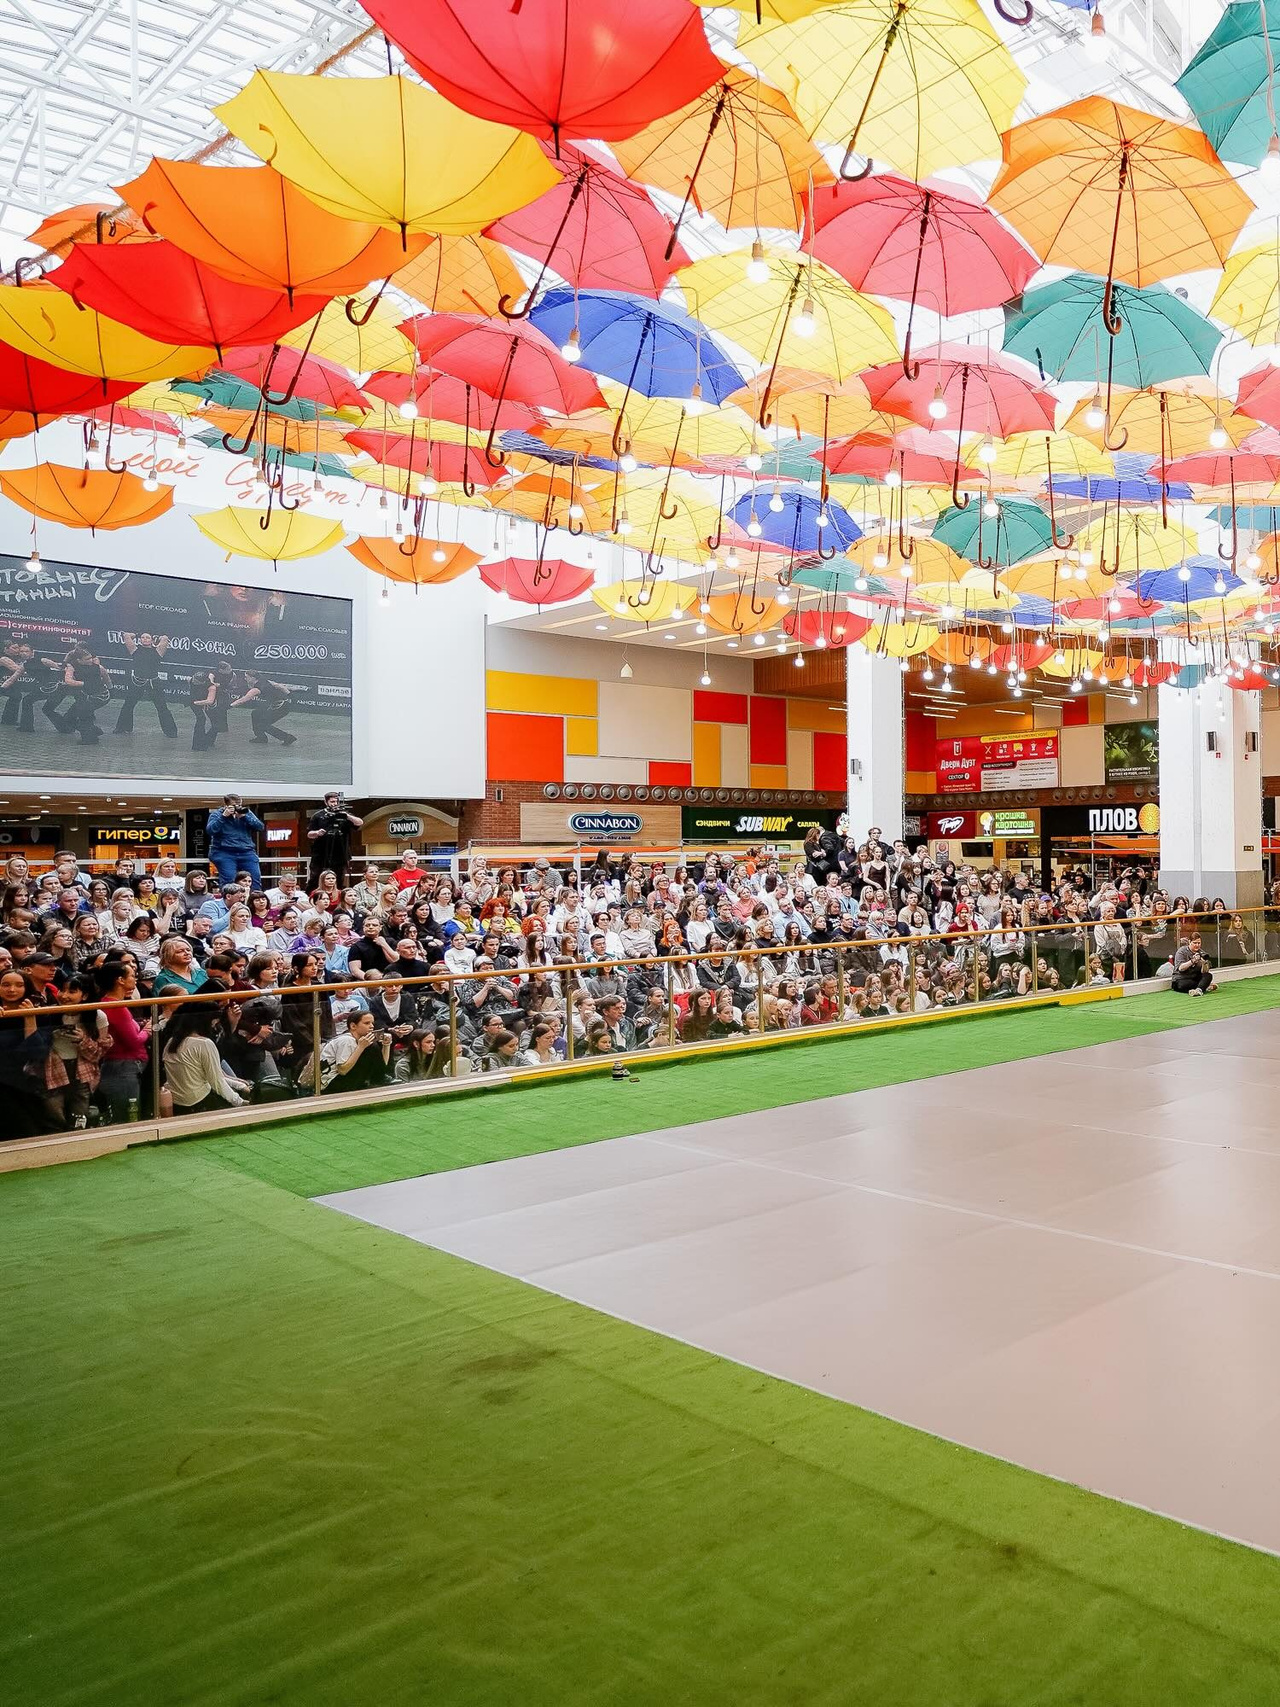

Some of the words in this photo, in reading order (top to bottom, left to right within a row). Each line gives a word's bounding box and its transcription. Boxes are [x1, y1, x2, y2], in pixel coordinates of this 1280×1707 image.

[254, 643, 329, 660] 250.000
[961, 757, 976, 770] Дуэт
[575, 816, 638, 829] CINNABON
[995, 812, 1027, 822] крошка
[1089, 808, 1138, 831] ПЛОВ
[696, 820, 731, 828] СЭНДВИЧИ
[735, 815, 793, 833] SUBWAY
[995, 820, 1035, 831] картошка
[98, 828, 151, 842] гипер
